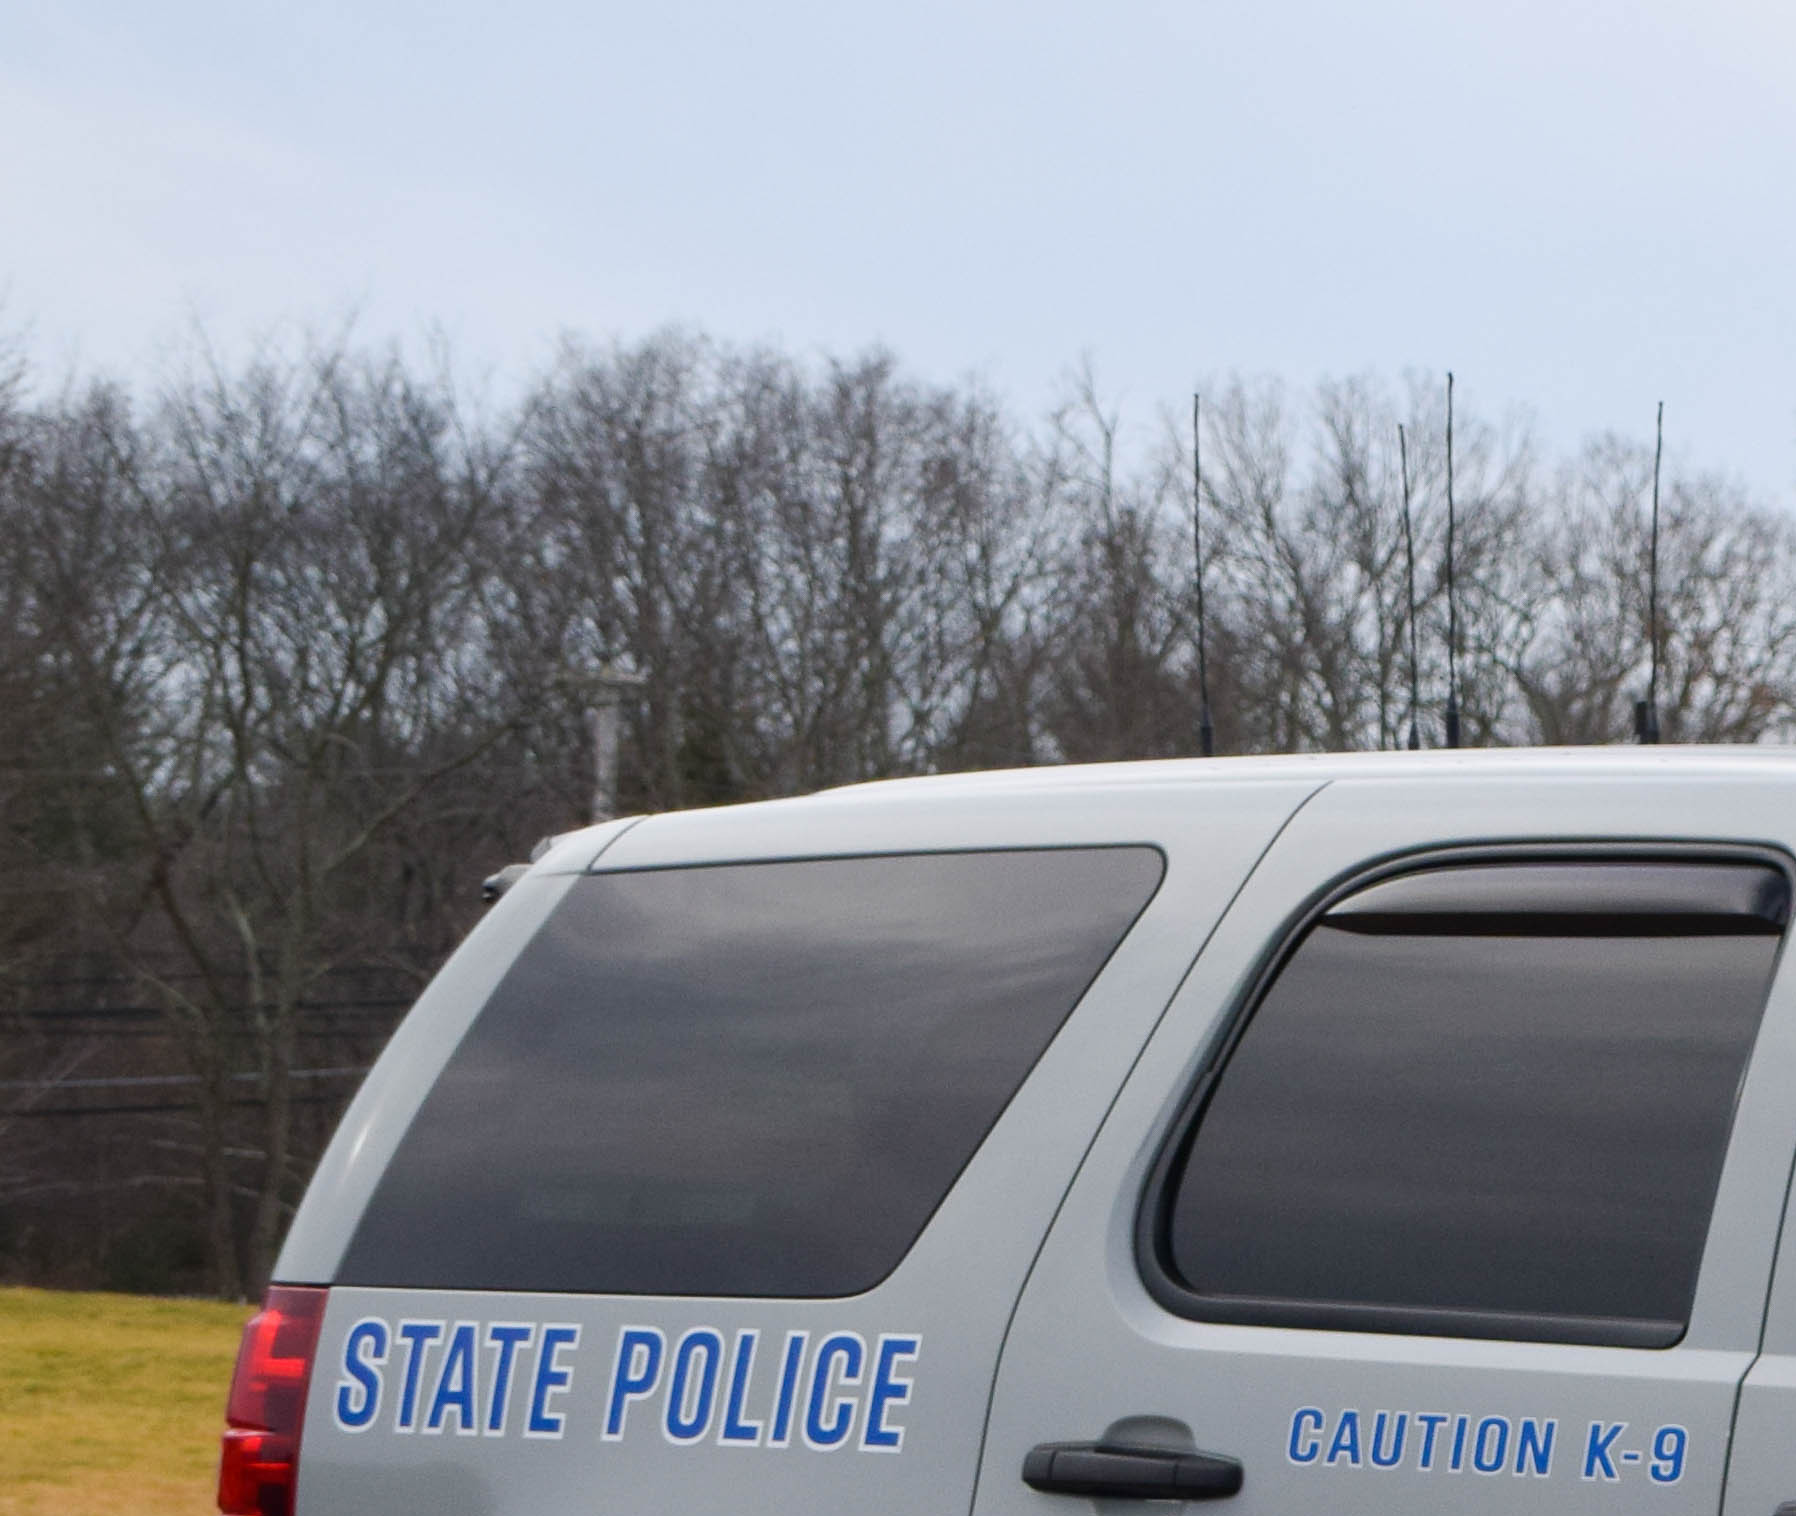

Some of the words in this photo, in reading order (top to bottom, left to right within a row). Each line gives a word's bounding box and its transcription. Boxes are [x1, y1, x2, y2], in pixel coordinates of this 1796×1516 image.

[333, 1315, 581, 1439] STATE
[602, 1325, 922, 1453] POLICE
[1287, 1405, 1559, 1478] CAUTION
[1580, 1420, 1689, 1486] K-9
